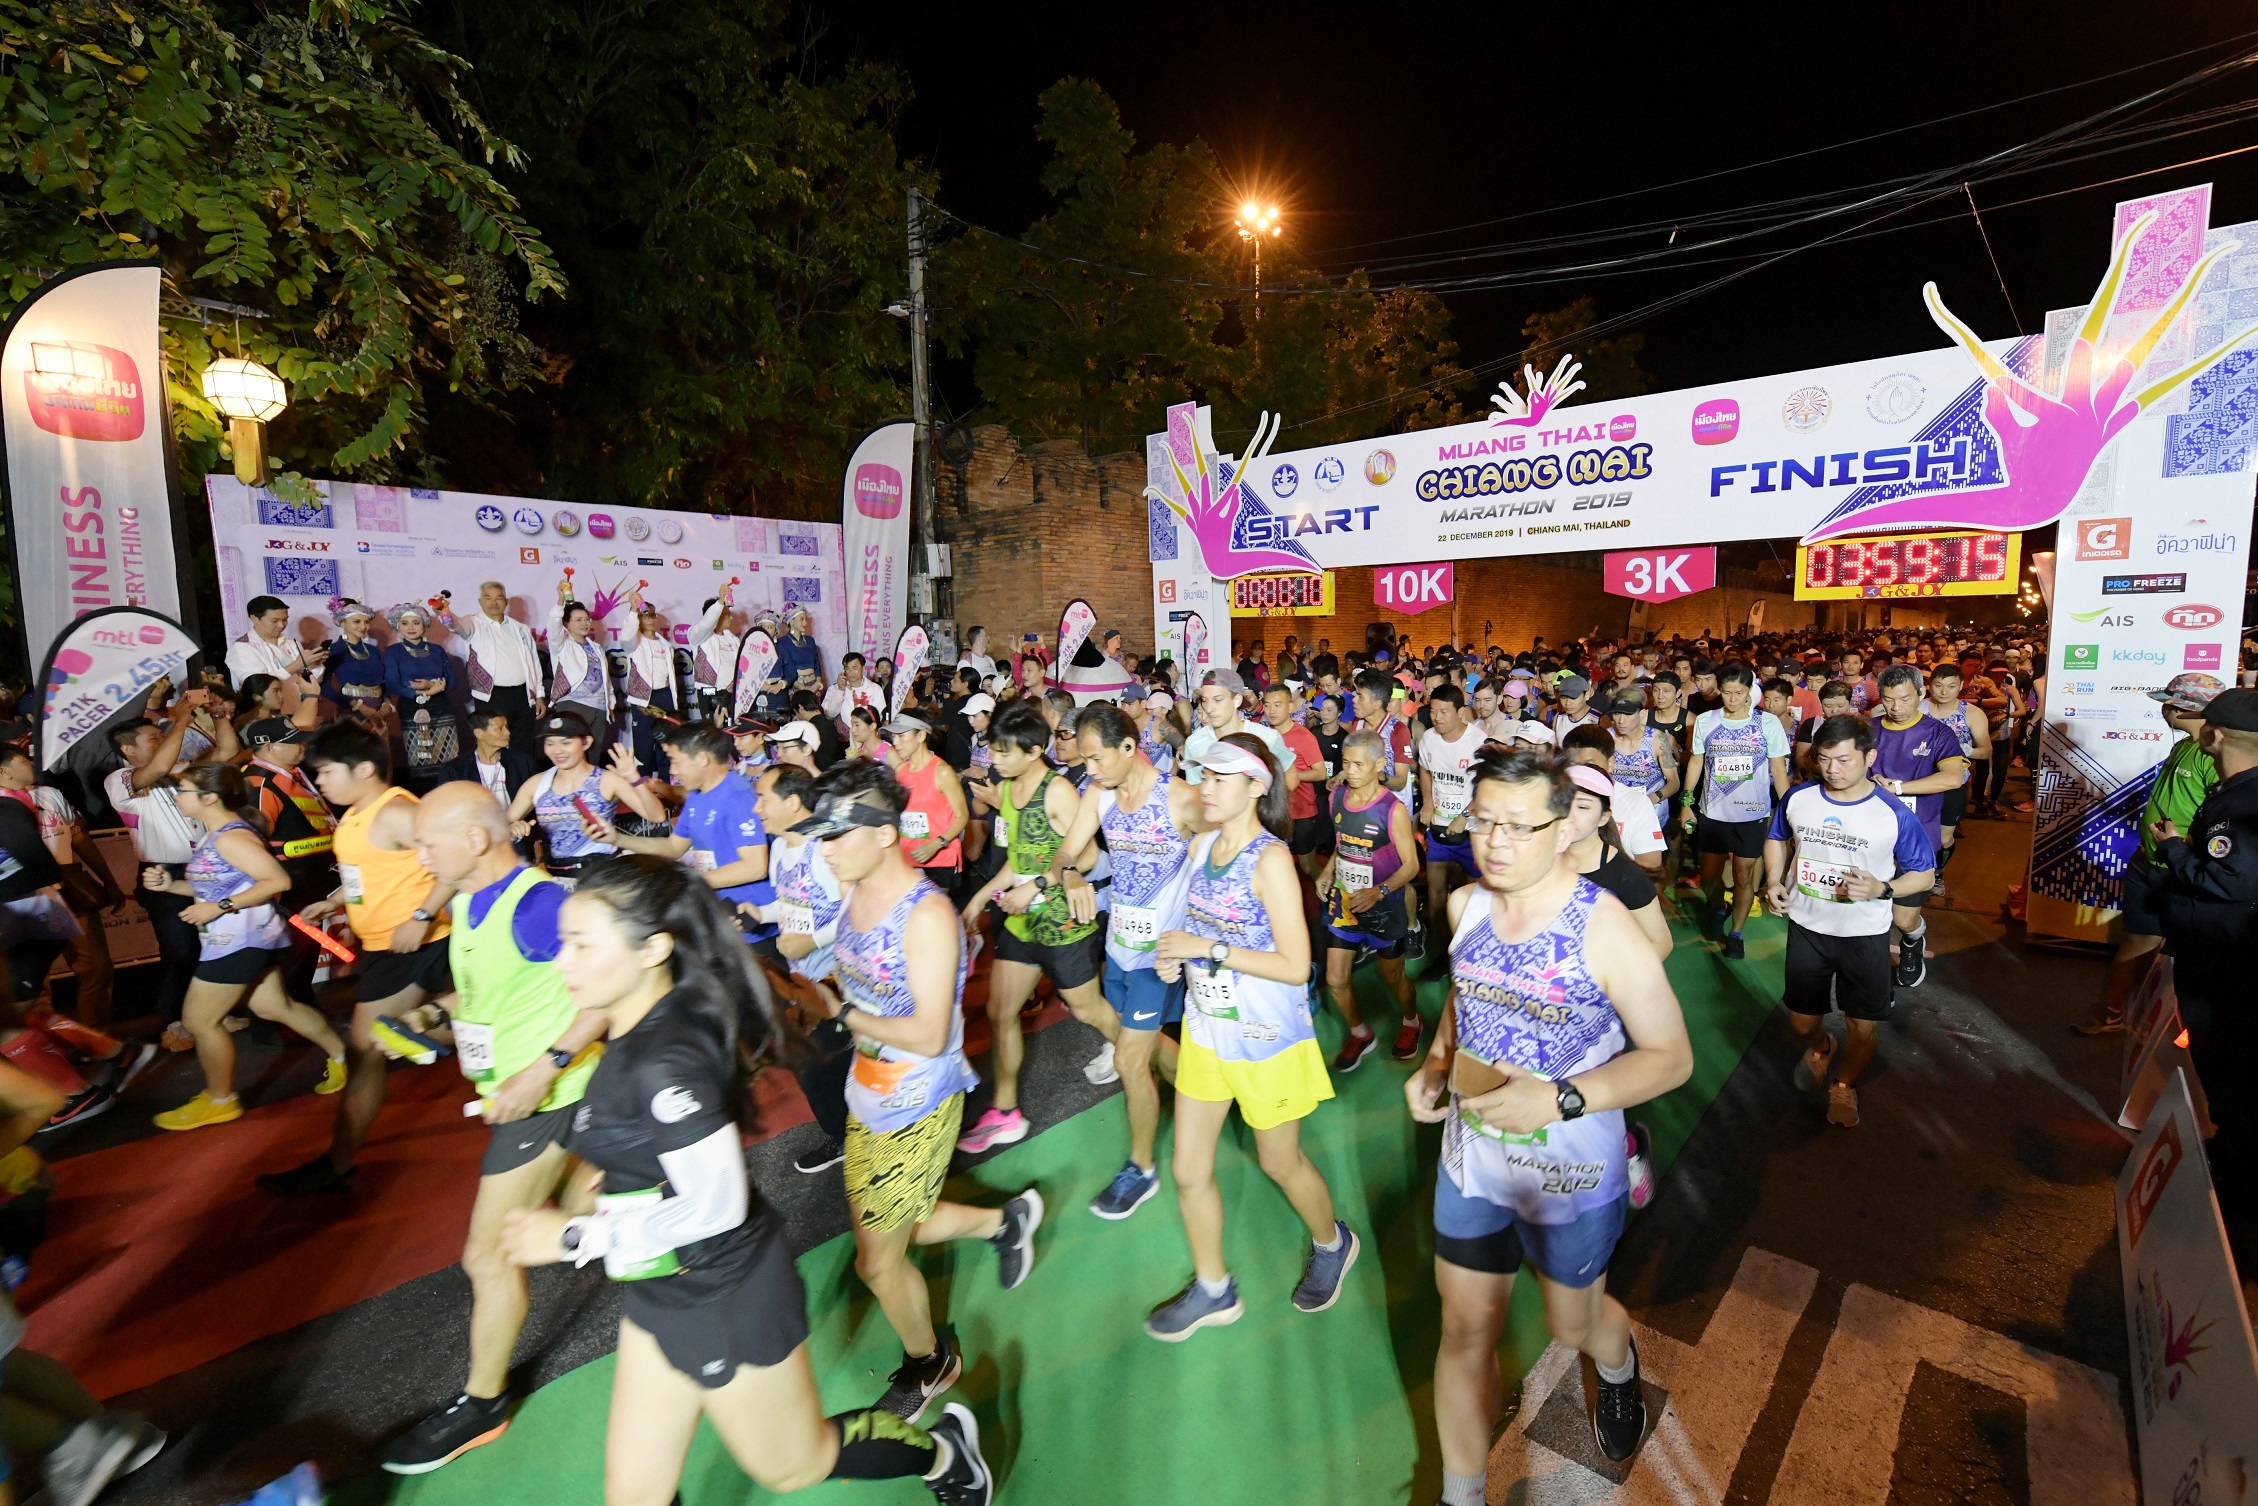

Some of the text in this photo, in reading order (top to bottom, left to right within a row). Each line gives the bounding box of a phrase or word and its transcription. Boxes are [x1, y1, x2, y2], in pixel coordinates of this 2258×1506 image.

[1695, 411, 1737, 426] เมืองไทย
[1439, 423, 1606, 461] MUANG THAI
[1417, 444, 1652, 501] CHIANG MAI
[1711, 440, 1967, 498] FINISH
[858, 481, 899, 496] เมืองไทย
[1440, 491, 1633, 523] MARATHON 2019
[1248, 505, 1380, 542] START
[1450, 531, 1493, 541] DECEMBER
[1494, 529, 1514, 538] 2019
[1527, 525, 1561, 535] CHIANG
[1562, 524, 1582, 533] MAI,
[1584, 519, 1631, 531] THAILAND
[61, 485, 110, 606] INESS
[265, 540, 330, 551] JOG & JOY
[2087, 524, 2117, 549] G
[118, 506, 147, 606] ERYTHING
[524, 550, 534, 561] G
[1806, 533, 2006, 587] 03:59:15
[1624, 554, 1692, 594] 3K
[2106, 578, 2181, 588] PRO FREEZE
[1163, 582, 1172, 596] G
[1235, 576, 1323, 608] 00:00:10
[1380, 569, 1446, 603] 10K
[1911, 582, 1947, 597] JOY
[862, 545, 880, 679] HAPPINESS
[883, 556, 893, 660] EANS EVERYTHING
[2100, 615, 2134, 627] AIS
[93, 631, 138, 647] mtl
[749, 643, 761, 654] mtl
[1062, 649, 1075, 670] PACER
[1063, 643, 1072, 657] 21K
[2113, 649, 2166, 665] kkday
[61, 692, 99, 720] 21K
[895, 684, 908, 711] PACER
[58, 703, 112, 743] PACER
[2102, 731, 2127, 740] JOG
[2140, 733, 2163, 741] JOY
[1709, 745, 1740, 753] CHIANG
[1717, 763, 1751, 772] 40 4816
[1441, 801, 1462, 810] 4520
[1797, 825, 1869, 849] FINISHER
[1345, 871, 1370, 885] 5870
[1801, 870, 1845, 888] 30 457
[1125, 919, 1152, 934] 4968
[1456, 962, 1547, 996] MUANG THAI
[1454, 976, 1572, 1025] HIANG MAI
[1507, 1155, 1607, 1174] MARATHON
[1541, 1178, 1602, 1193] 2019
